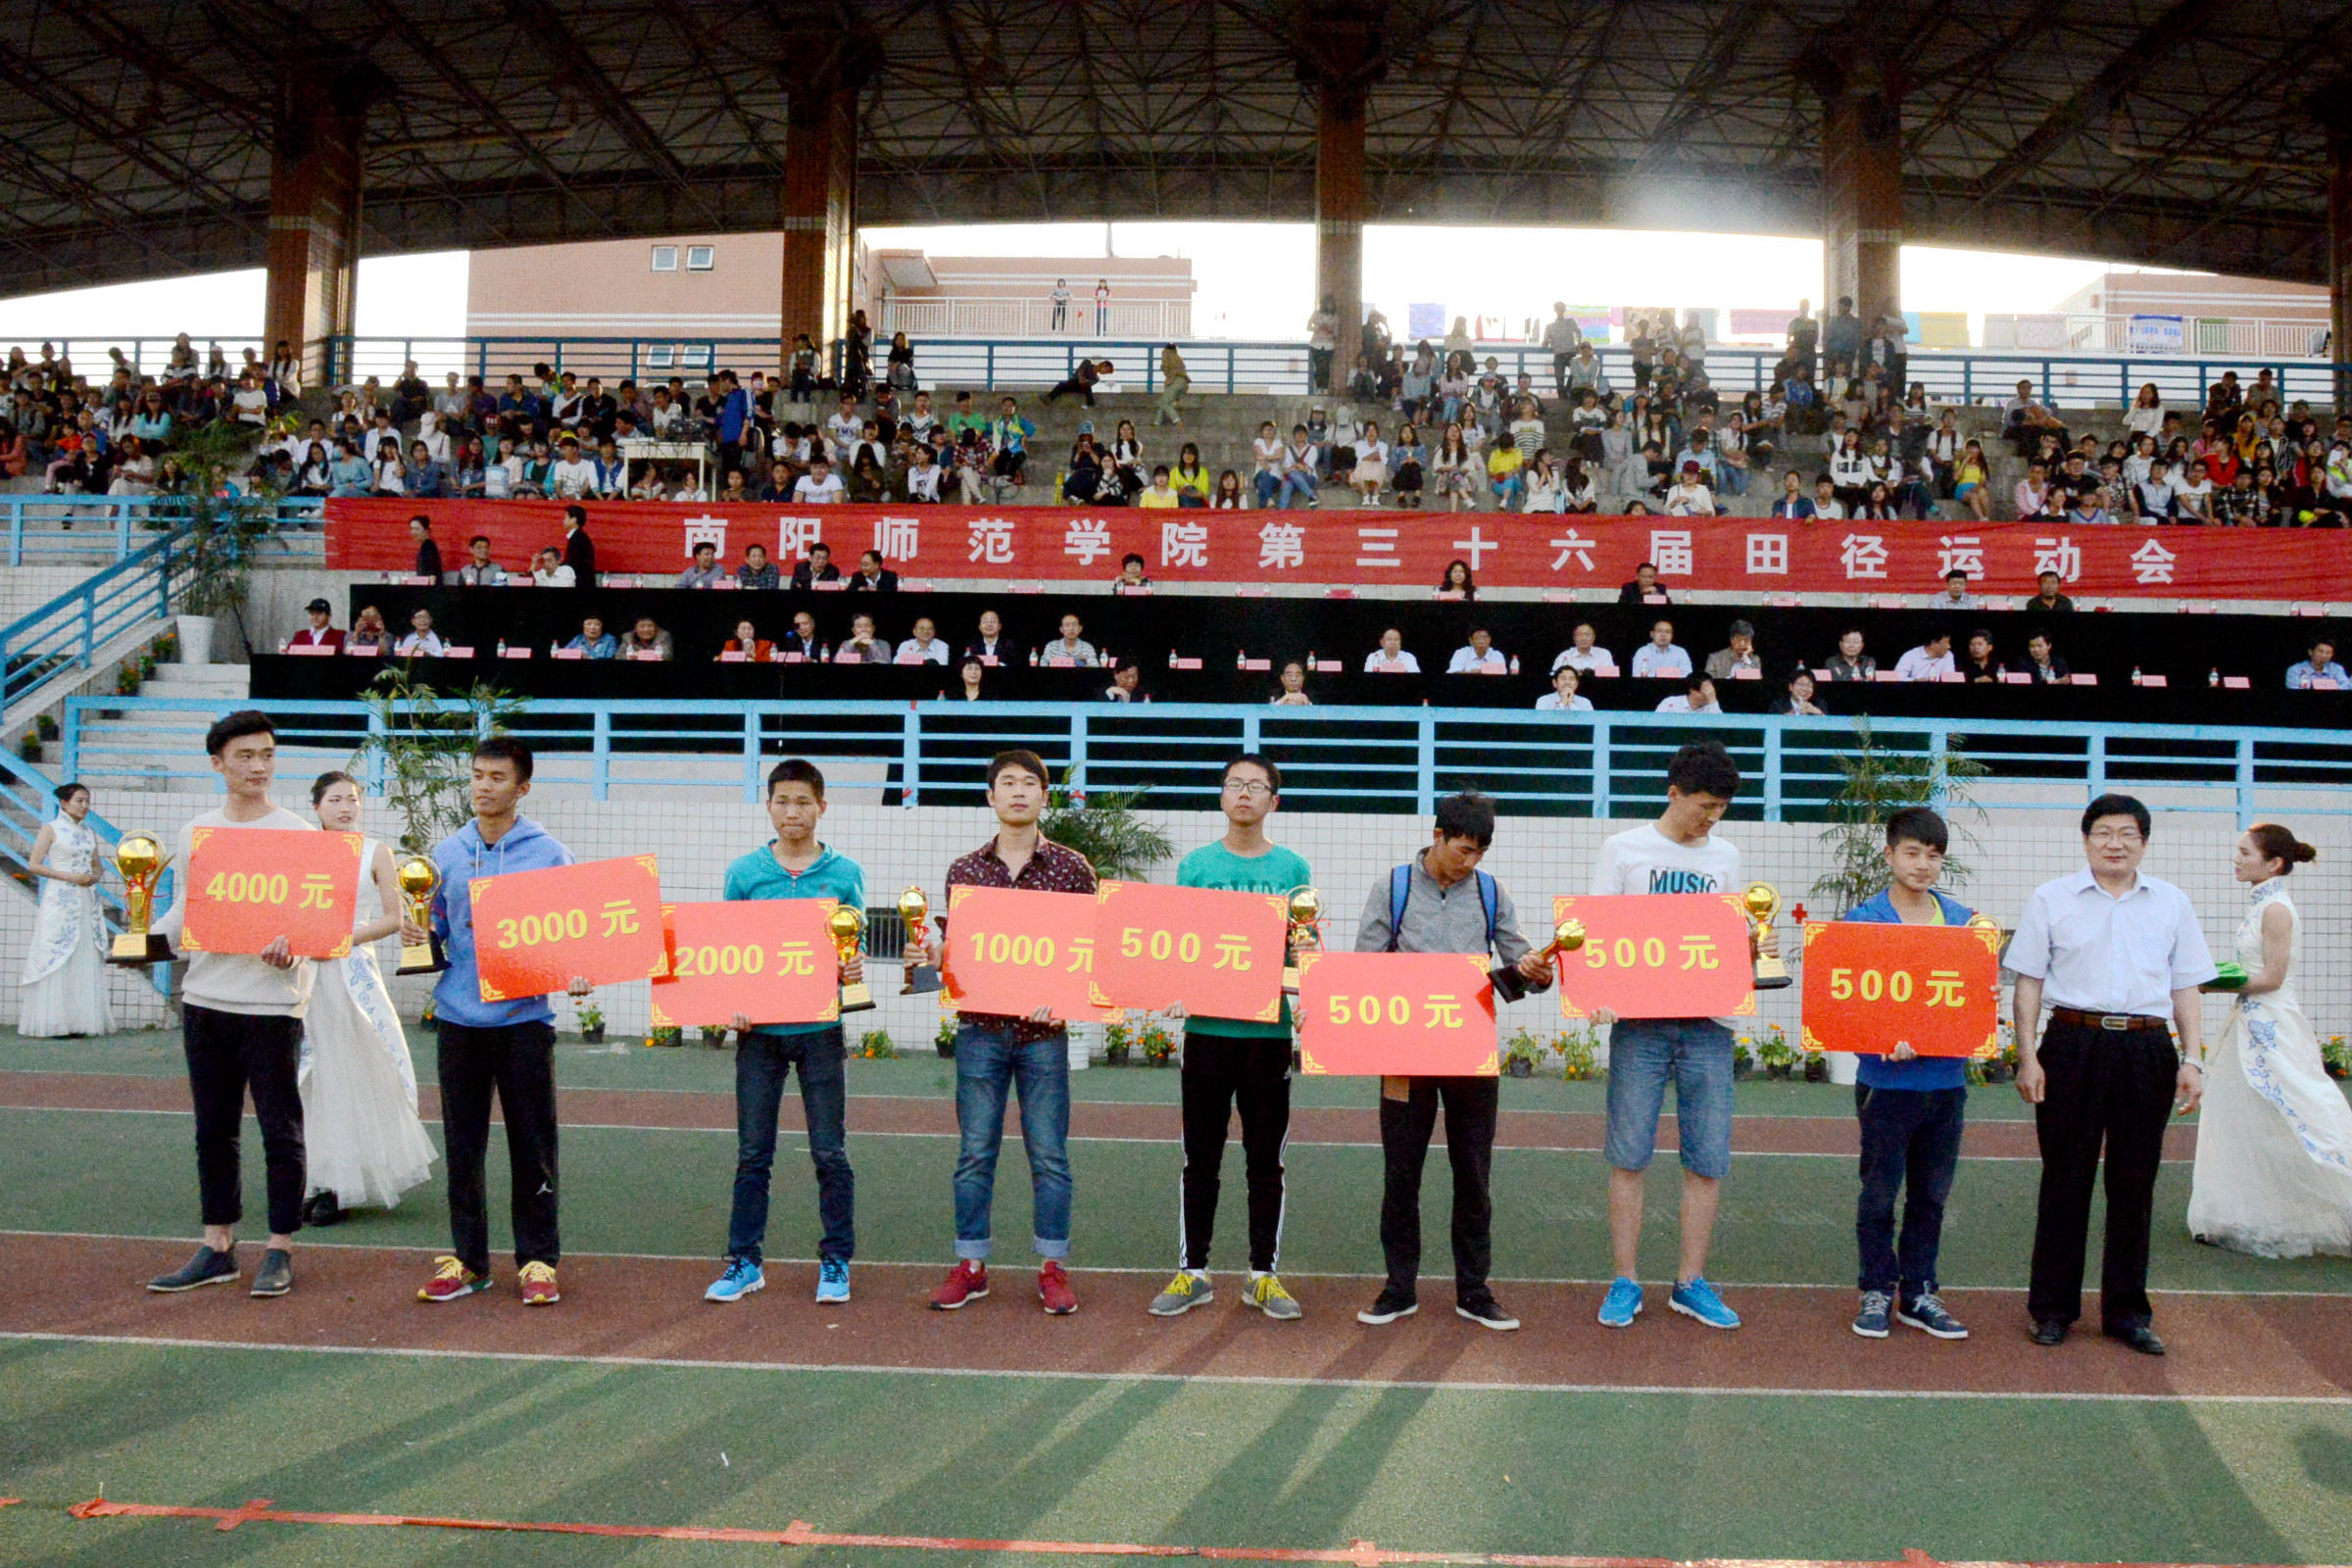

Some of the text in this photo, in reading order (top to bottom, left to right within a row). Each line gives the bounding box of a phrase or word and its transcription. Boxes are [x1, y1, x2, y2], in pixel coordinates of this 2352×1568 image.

[684, 514, 2178, 585] 南阳师范学院第三十六届田径运动会
[206, 872, 289, 905] 4000
[497, 908, 588, 950] 3000
[1120, 927, 1201, 963] 500
[673, 945, 764, 976] 2000
[970, 932, 1055, 968] 1000
[1584, 937, 1667, 968] 500
[1830, 968, 1913, 1003] 500
[1329, 996, 1411, 1025] 500
